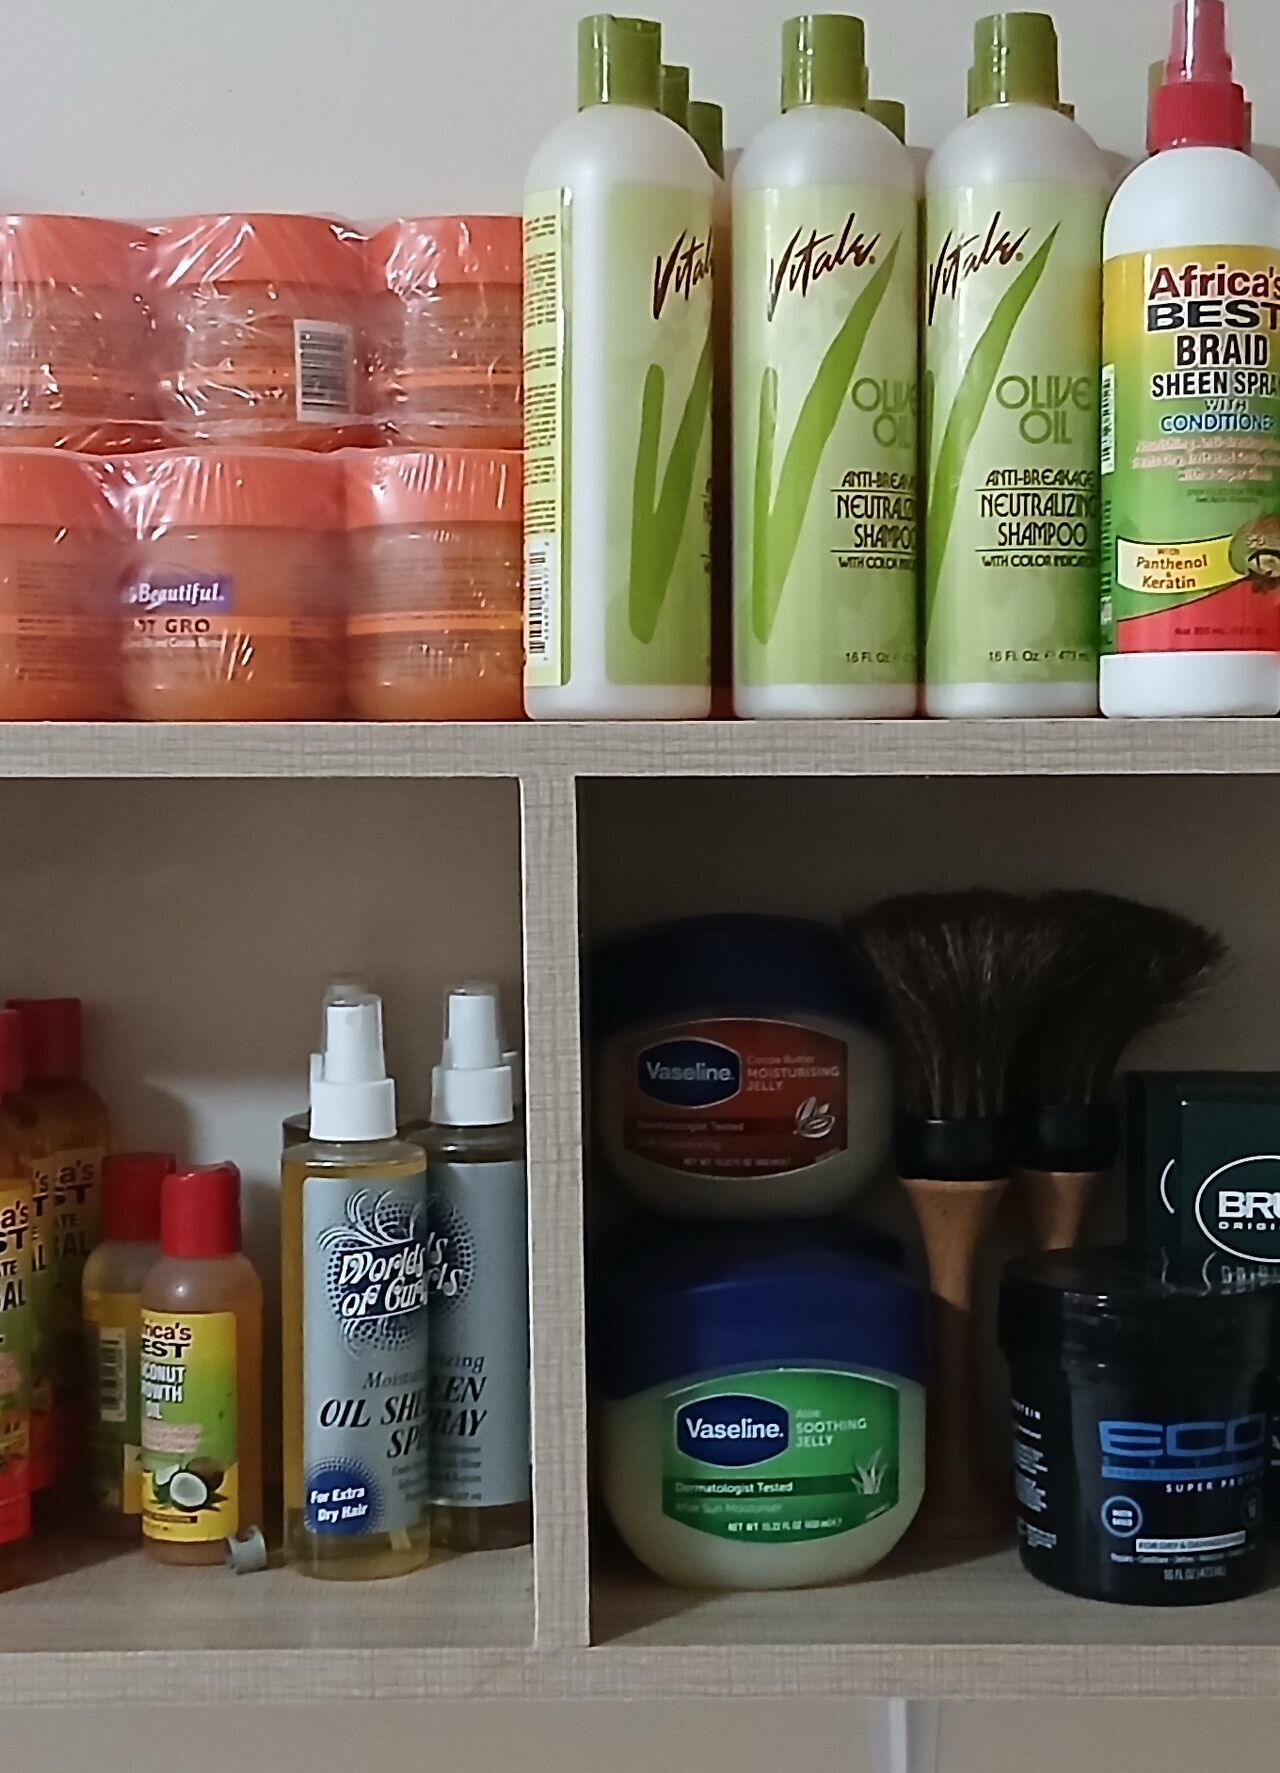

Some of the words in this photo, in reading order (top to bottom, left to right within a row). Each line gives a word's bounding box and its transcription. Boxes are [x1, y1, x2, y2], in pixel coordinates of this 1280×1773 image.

[654, 228, 714, 320] Vital
[1177, 334, 1267, 366] BRAID
[996, 375, 1094, 410] OLIVE
[1152, 371, 1227, 397] SHEEN
[1205, 400, 1247, 411] WITH
[1020, 410, 1072, 444] OIL
[986, 468, 1094, 488] ANTI-BREAKAGE
[998, 522, 1087, 547] SHAMPOO
[982, 556, 1008, 568] WITH
[1011, 555, 1052, 568] COLOR
[1136, 555, 1208, 571] Panthenol
[1142, 575, 1196, 590] Keratin
[166, 618, 210, 633] GRO
[746, 1065, 840, 1080] MOISTURISING
[746, 1080, 784, 1092] JELLY
[710, 1121, 745, 1132] Tested
[142, 1340, 191, 1359] EST
[320, 1398, 371, 1429] OIL
[796, 1417, 868, 1435] SOOTHING
[796, 1434, 833, 1449] JELLY
[1099, 1413, 1265, 1458] ECO
[311, 1489, 329, 1504] For
[332, 1486, 366, 1502] Extra
[675, 1481, 754, 1496] Dermatologist
[757, 1481, 794, 1493] Tested
[1165, 1481, 1213, 1494] SUPER
[318, 1507, 339, 1523] Dry
[341, 1503, 369, 1519] Hair
